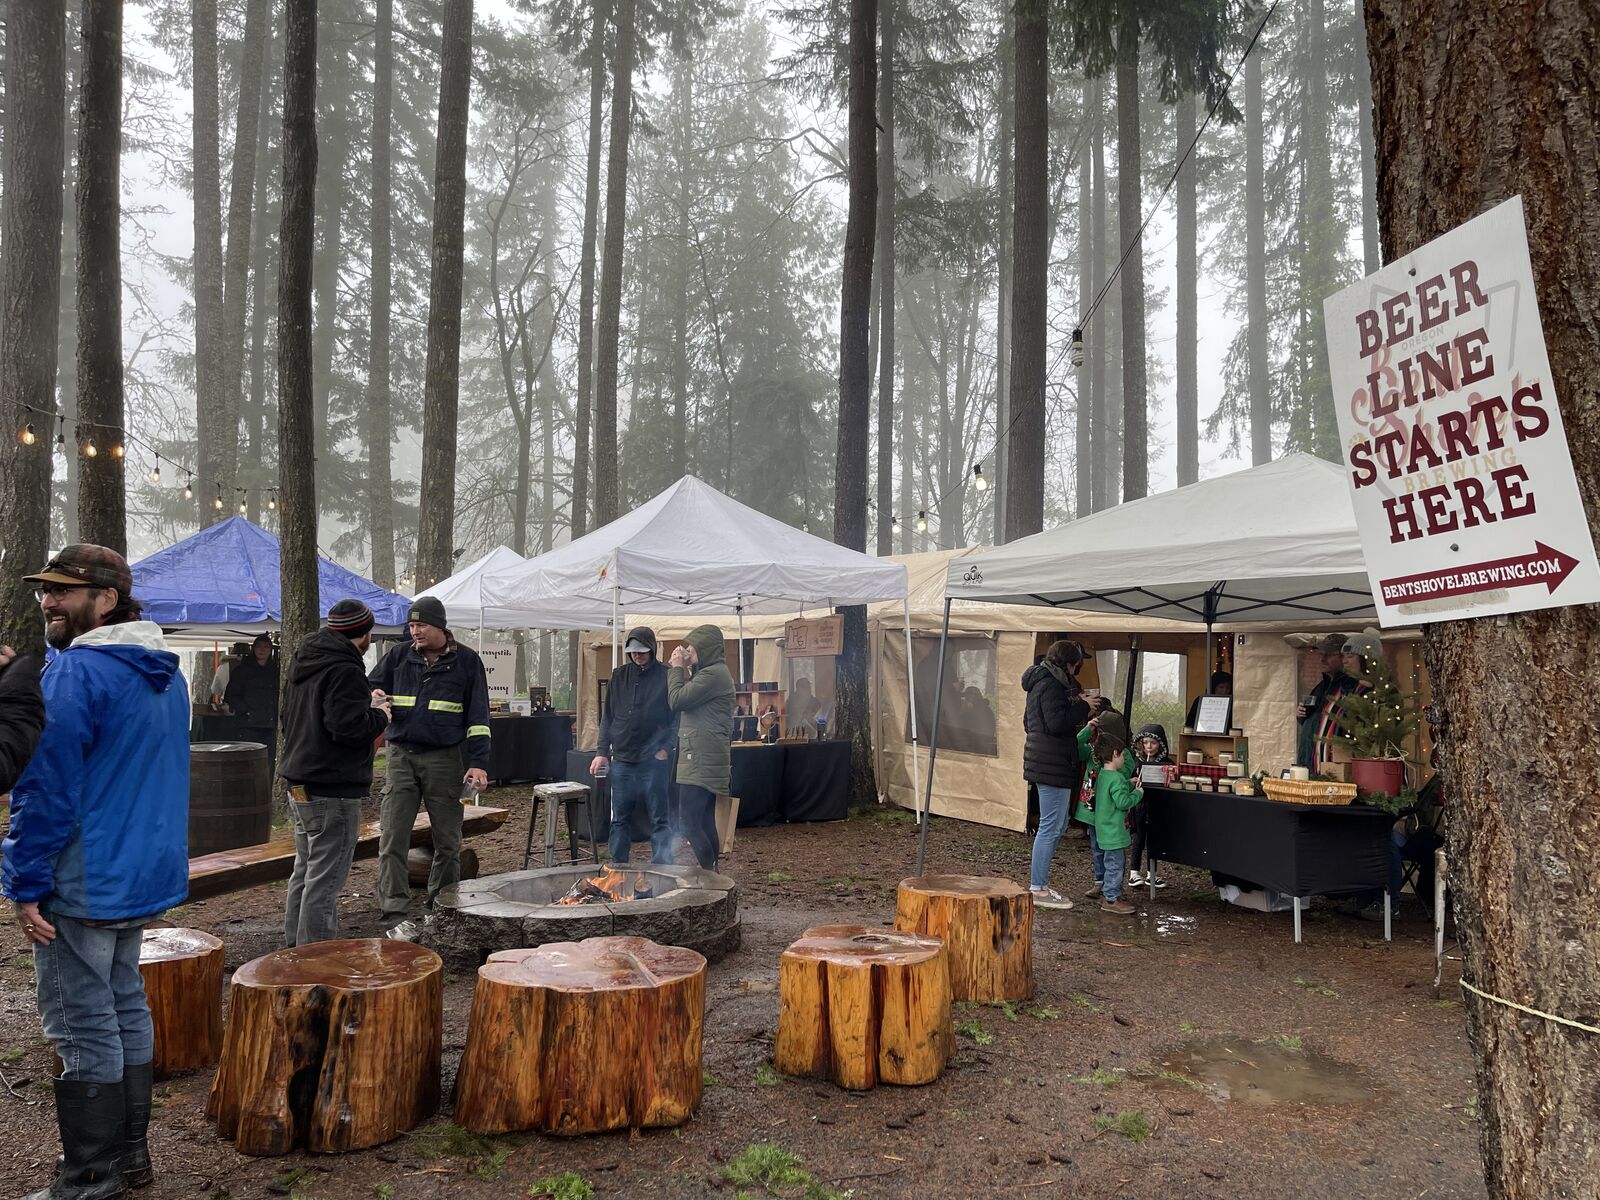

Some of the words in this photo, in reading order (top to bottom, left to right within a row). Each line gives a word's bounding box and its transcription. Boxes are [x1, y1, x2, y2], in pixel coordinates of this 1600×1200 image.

[1356, 260, 1489, 359] BEER
[1401, 327, 1445, 352] OREGON
[1366, 327, 1495, 419] LINE
[1350, 383, 1550, 489] STARTS
[1403, 447, 1518, 494] BREWING
[1382, 464, 1537, 544] HERE
[1383, 558, 1562, 599] BENTSHOVELBREWING.COM
